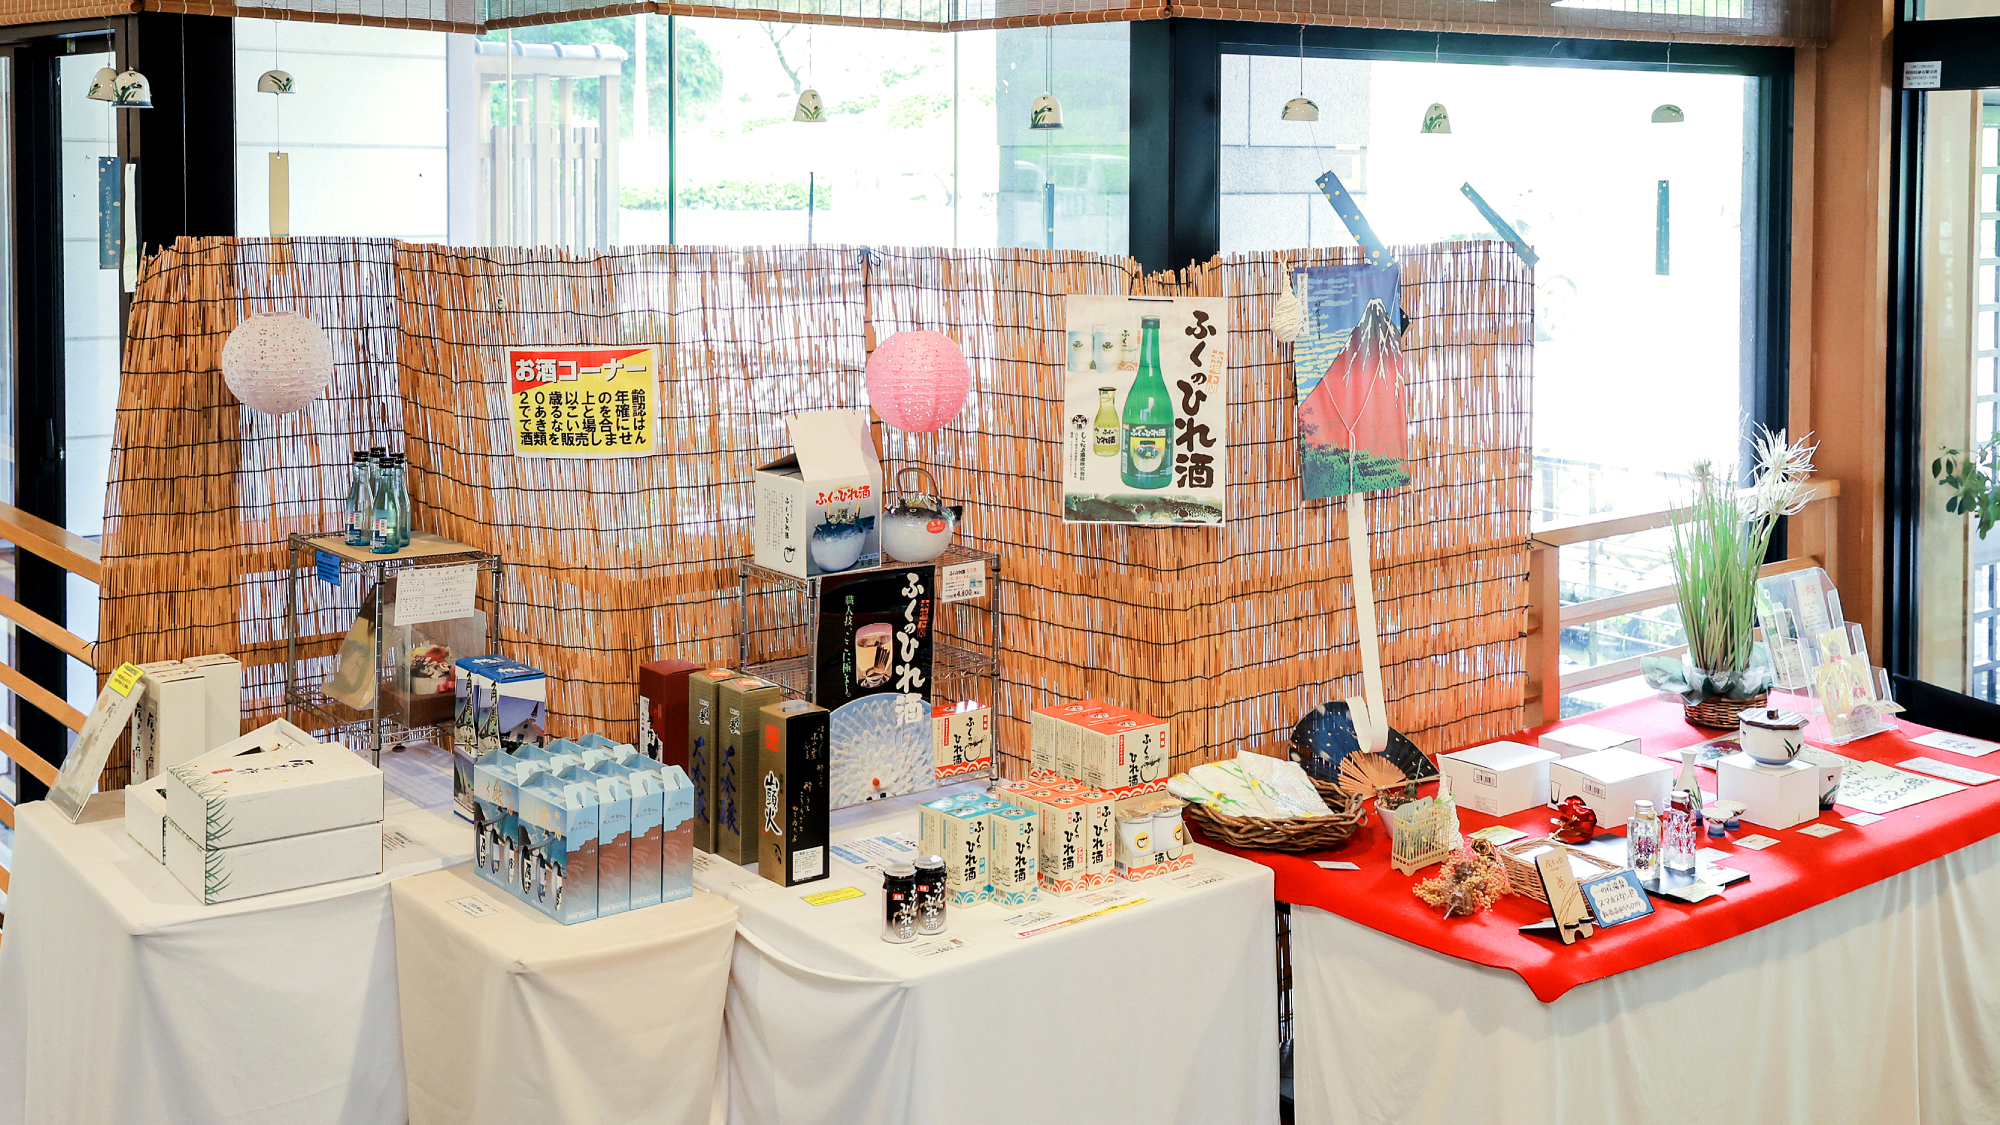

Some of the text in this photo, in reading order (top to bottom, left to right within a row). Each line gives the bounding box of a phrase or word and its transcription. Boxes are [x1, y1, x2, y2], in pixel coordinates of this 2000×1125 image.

[515, 357, 647, 383] お酒コーナー
[519, 403, 647, 418] であることを確認
[1174, 310, 1217, 489] ふくのひれ酒
[519, 418, 646, 432] できない場合には
[520, 431, 647, 446] 酒類を販売しません
[815, 485, 871, 506] ふくのひれ酒
[895, 572, 925, 725] ふくのひれ酒
[965, 716, 975, 742] ふくの
[952, 733, 963, 766] ひれ酒
[1142, 733, 1152, 760] ふくの
[1128, 752, 1140, 787] ひれ酒
[764, 770, 783, 836] 山頭火
[1072, 811, 1083, 839] ふくの
[1101, 805, 1111, 833] ふくの
[974, 821, 985, 850] ふくの
[1024, 823, 1034, 851] ふくの
[1063, 830, 1076, 870] ひれ酒
[1092, 825, 1105, 865] ひれ酒
[964, 841, 977, 882] ひれ酒
[1014, 842, 1027, 883] ひれ酒
[1154, 852, 1165, 865] 酒
[900, 903, 913, 939] ひれ酒
[925, 894, 939, 931] ひれ酒
